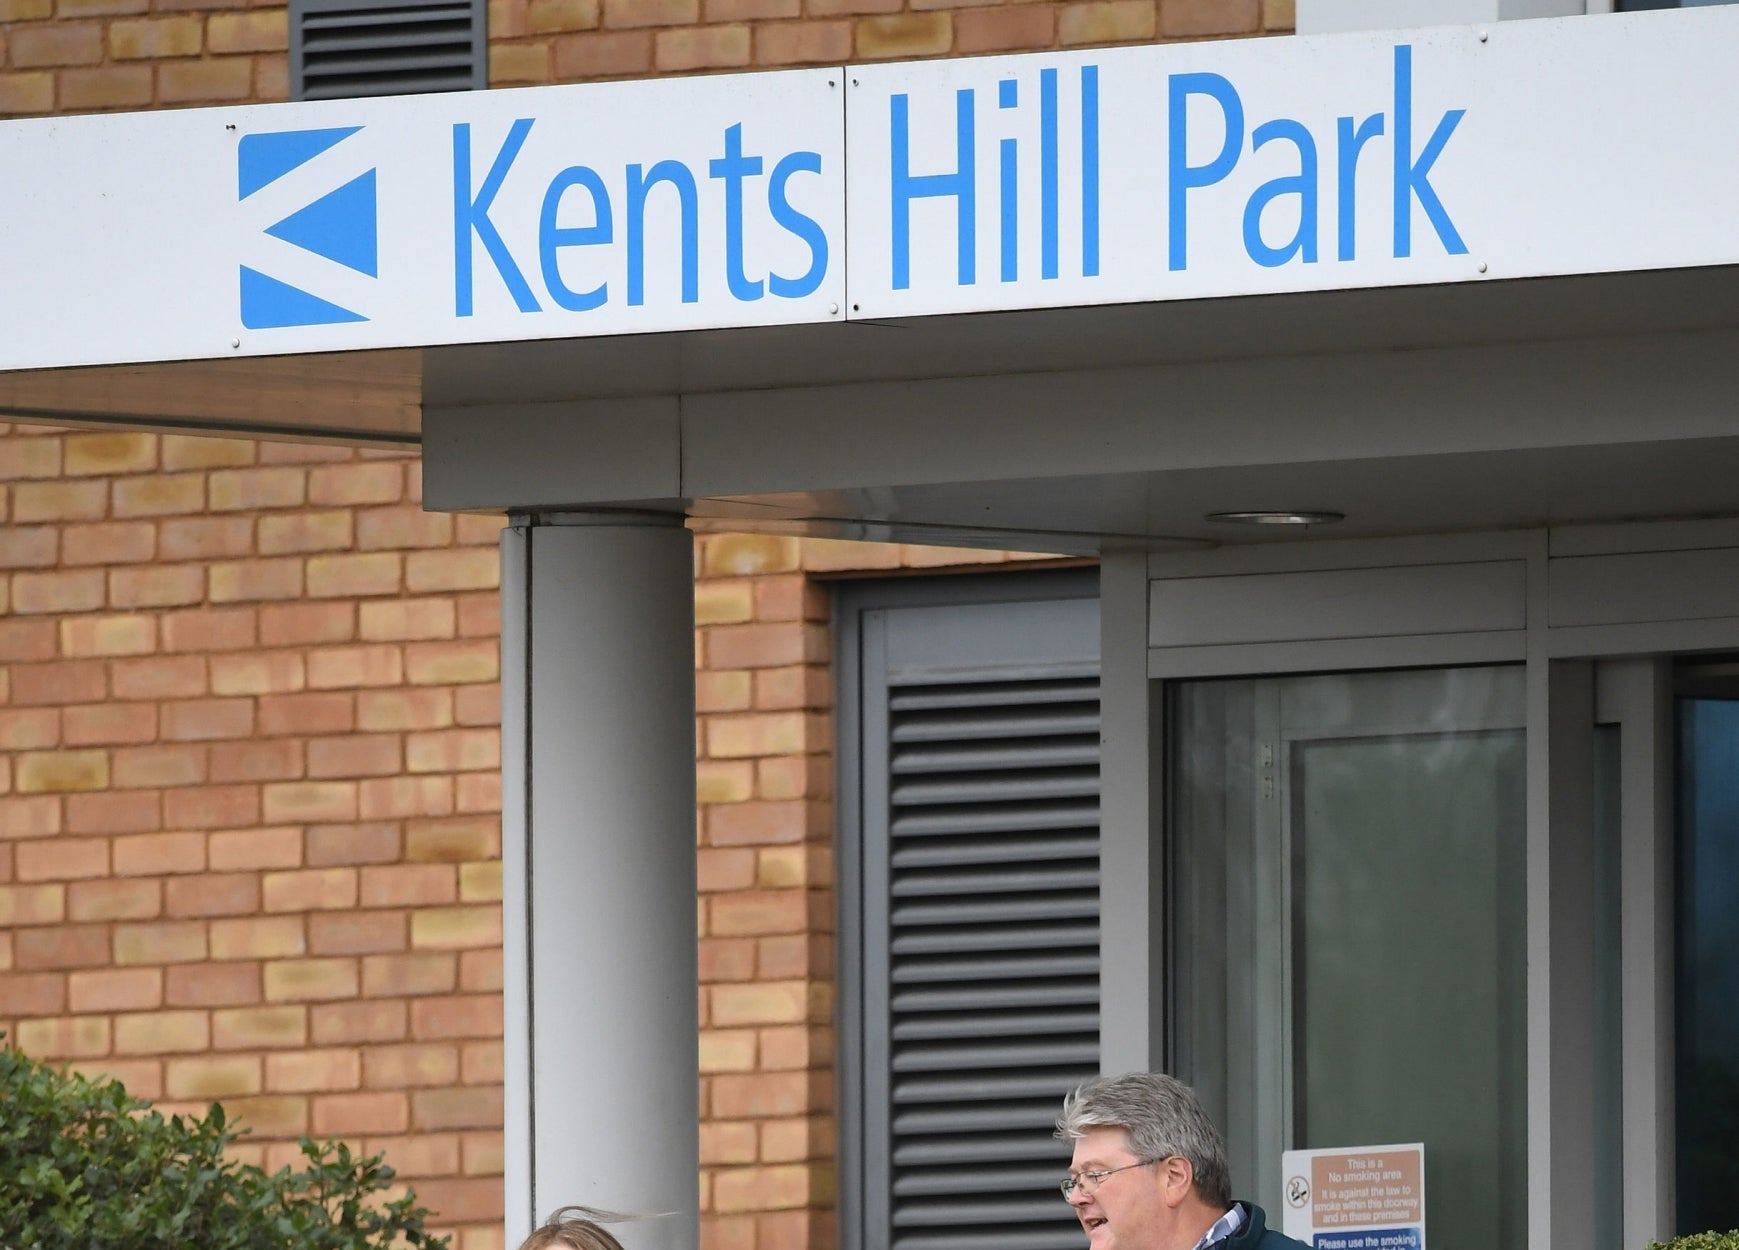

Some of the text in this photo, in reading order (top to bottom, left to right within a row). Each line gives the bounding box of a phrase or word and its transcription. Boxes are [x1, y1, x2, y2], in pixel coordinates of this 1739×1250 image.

[453, 45, 1469, 318] Kents Hill Park
[1347, 1159, 1383, 1169] This is a
[1328, 1170, 1401, 1183] No smoking area
[1322, 1185, 1411, 1200] It is against the law to
[1314, 1197, 1417, 1211] smoke within this doorway
[1323, 1209, 1409, 1223] and in these premises
[1318, 1235, 1416, 1249] Please use the smoking
